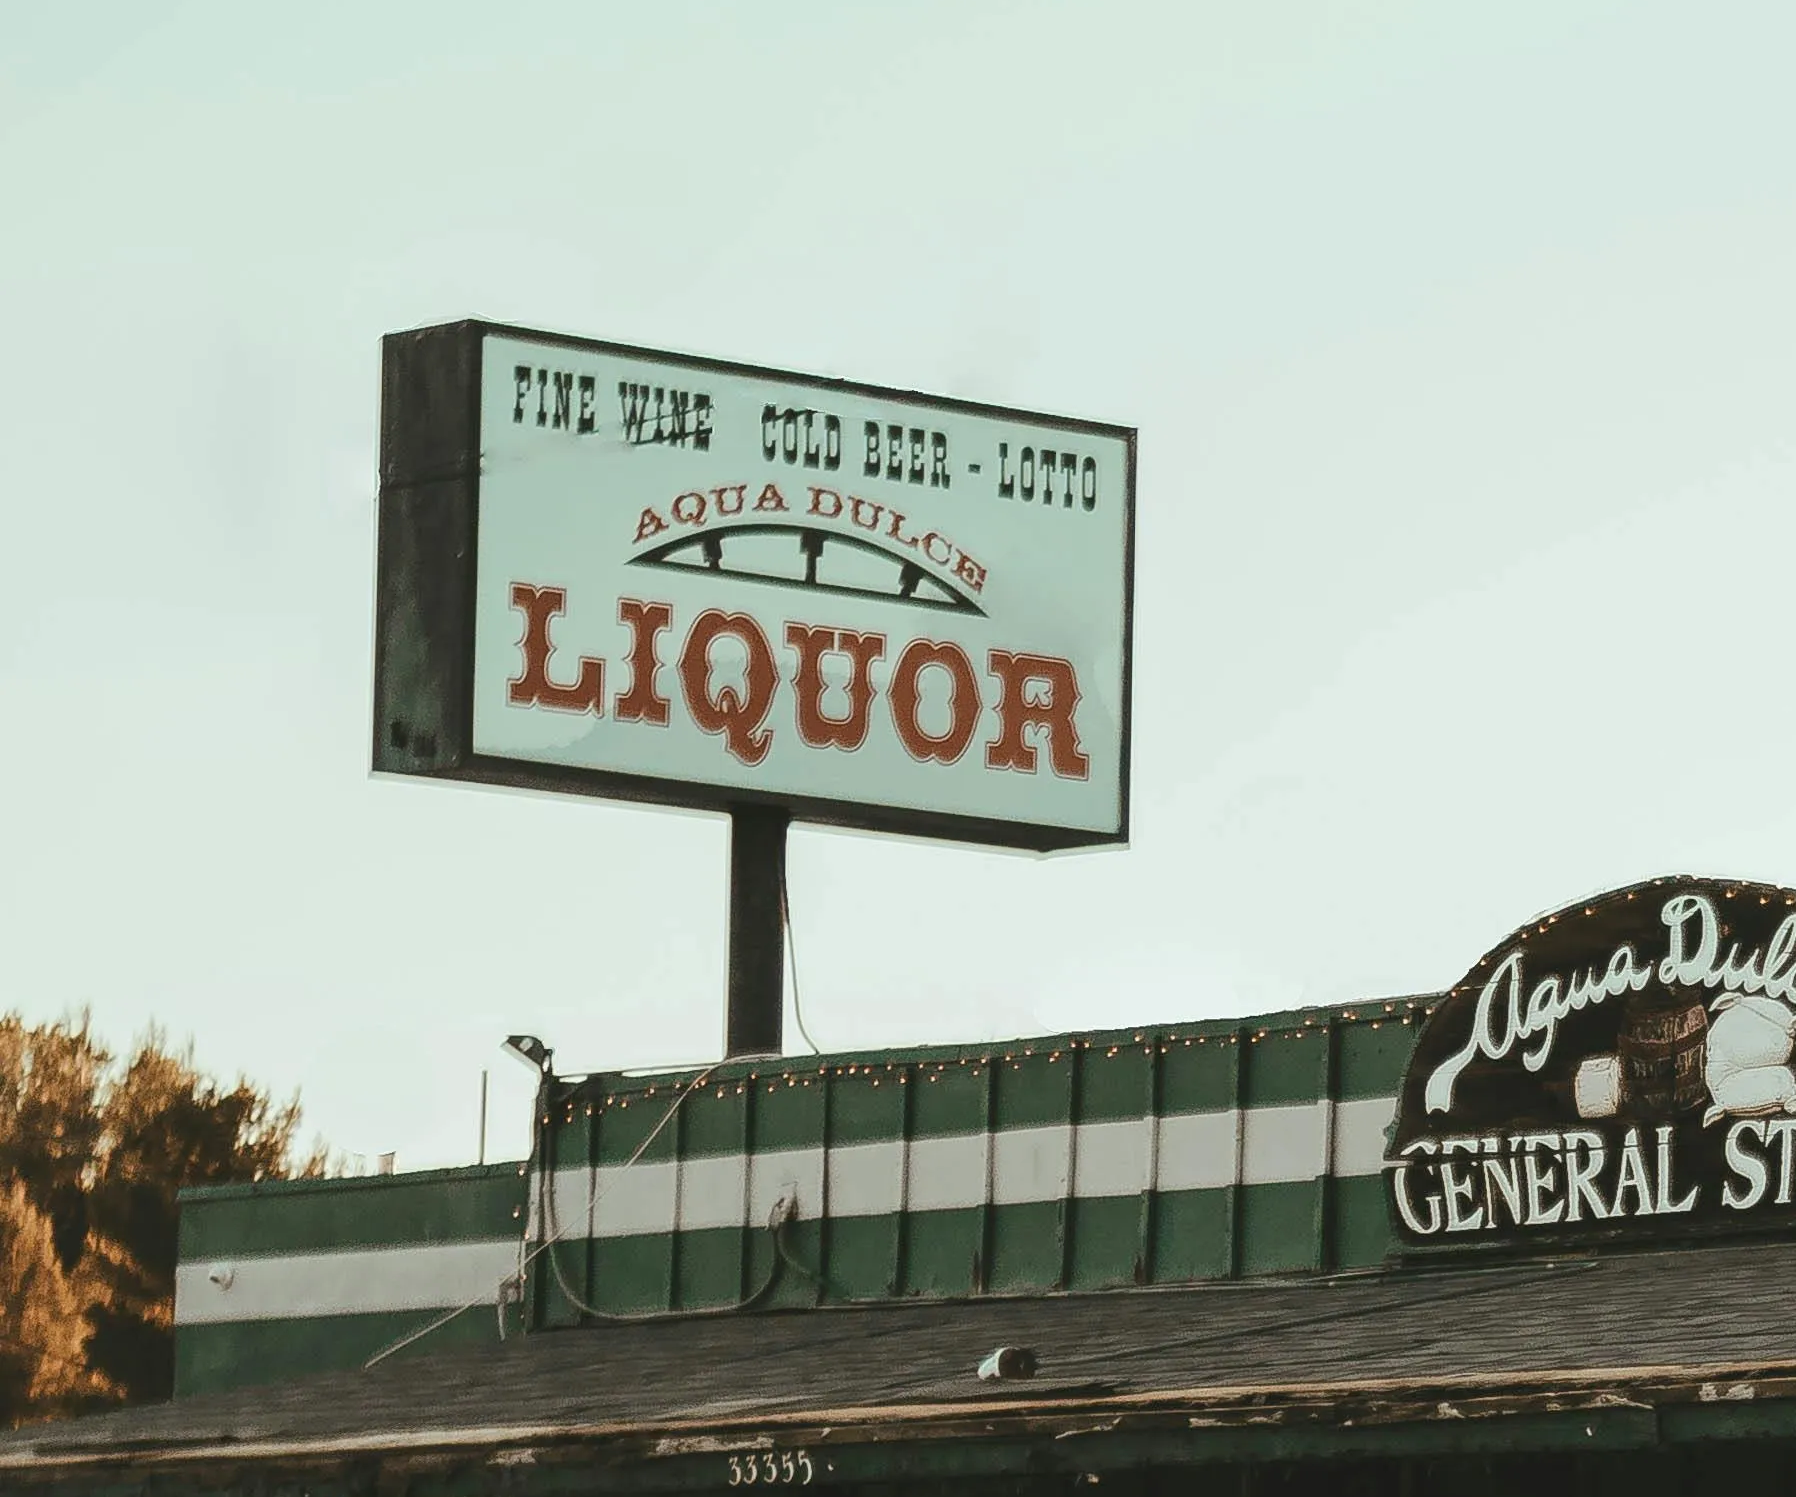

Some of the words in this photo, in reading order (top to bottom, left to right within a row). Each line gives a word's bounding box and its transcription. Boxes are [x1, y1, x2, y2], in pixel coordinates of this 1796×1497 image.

[512, 365, 597, 430] FINE
[617, 381, 715, 452] WINE
[760, 403, 842, 471] COLD
[863, 420, 951, 489] BEER
[997, 442, 1099, 513] LOTTO
[632, 483, 790, 544] AQUA
[806, 486, 988, 596] DULCE
[506, 582, 1090, 782] LIQUOR
[1425, 950, 1656, 1115] Agua
[1394, 1125, 1700, 1234] GENERAL
[728, 1449, 813, 1486] 33355
